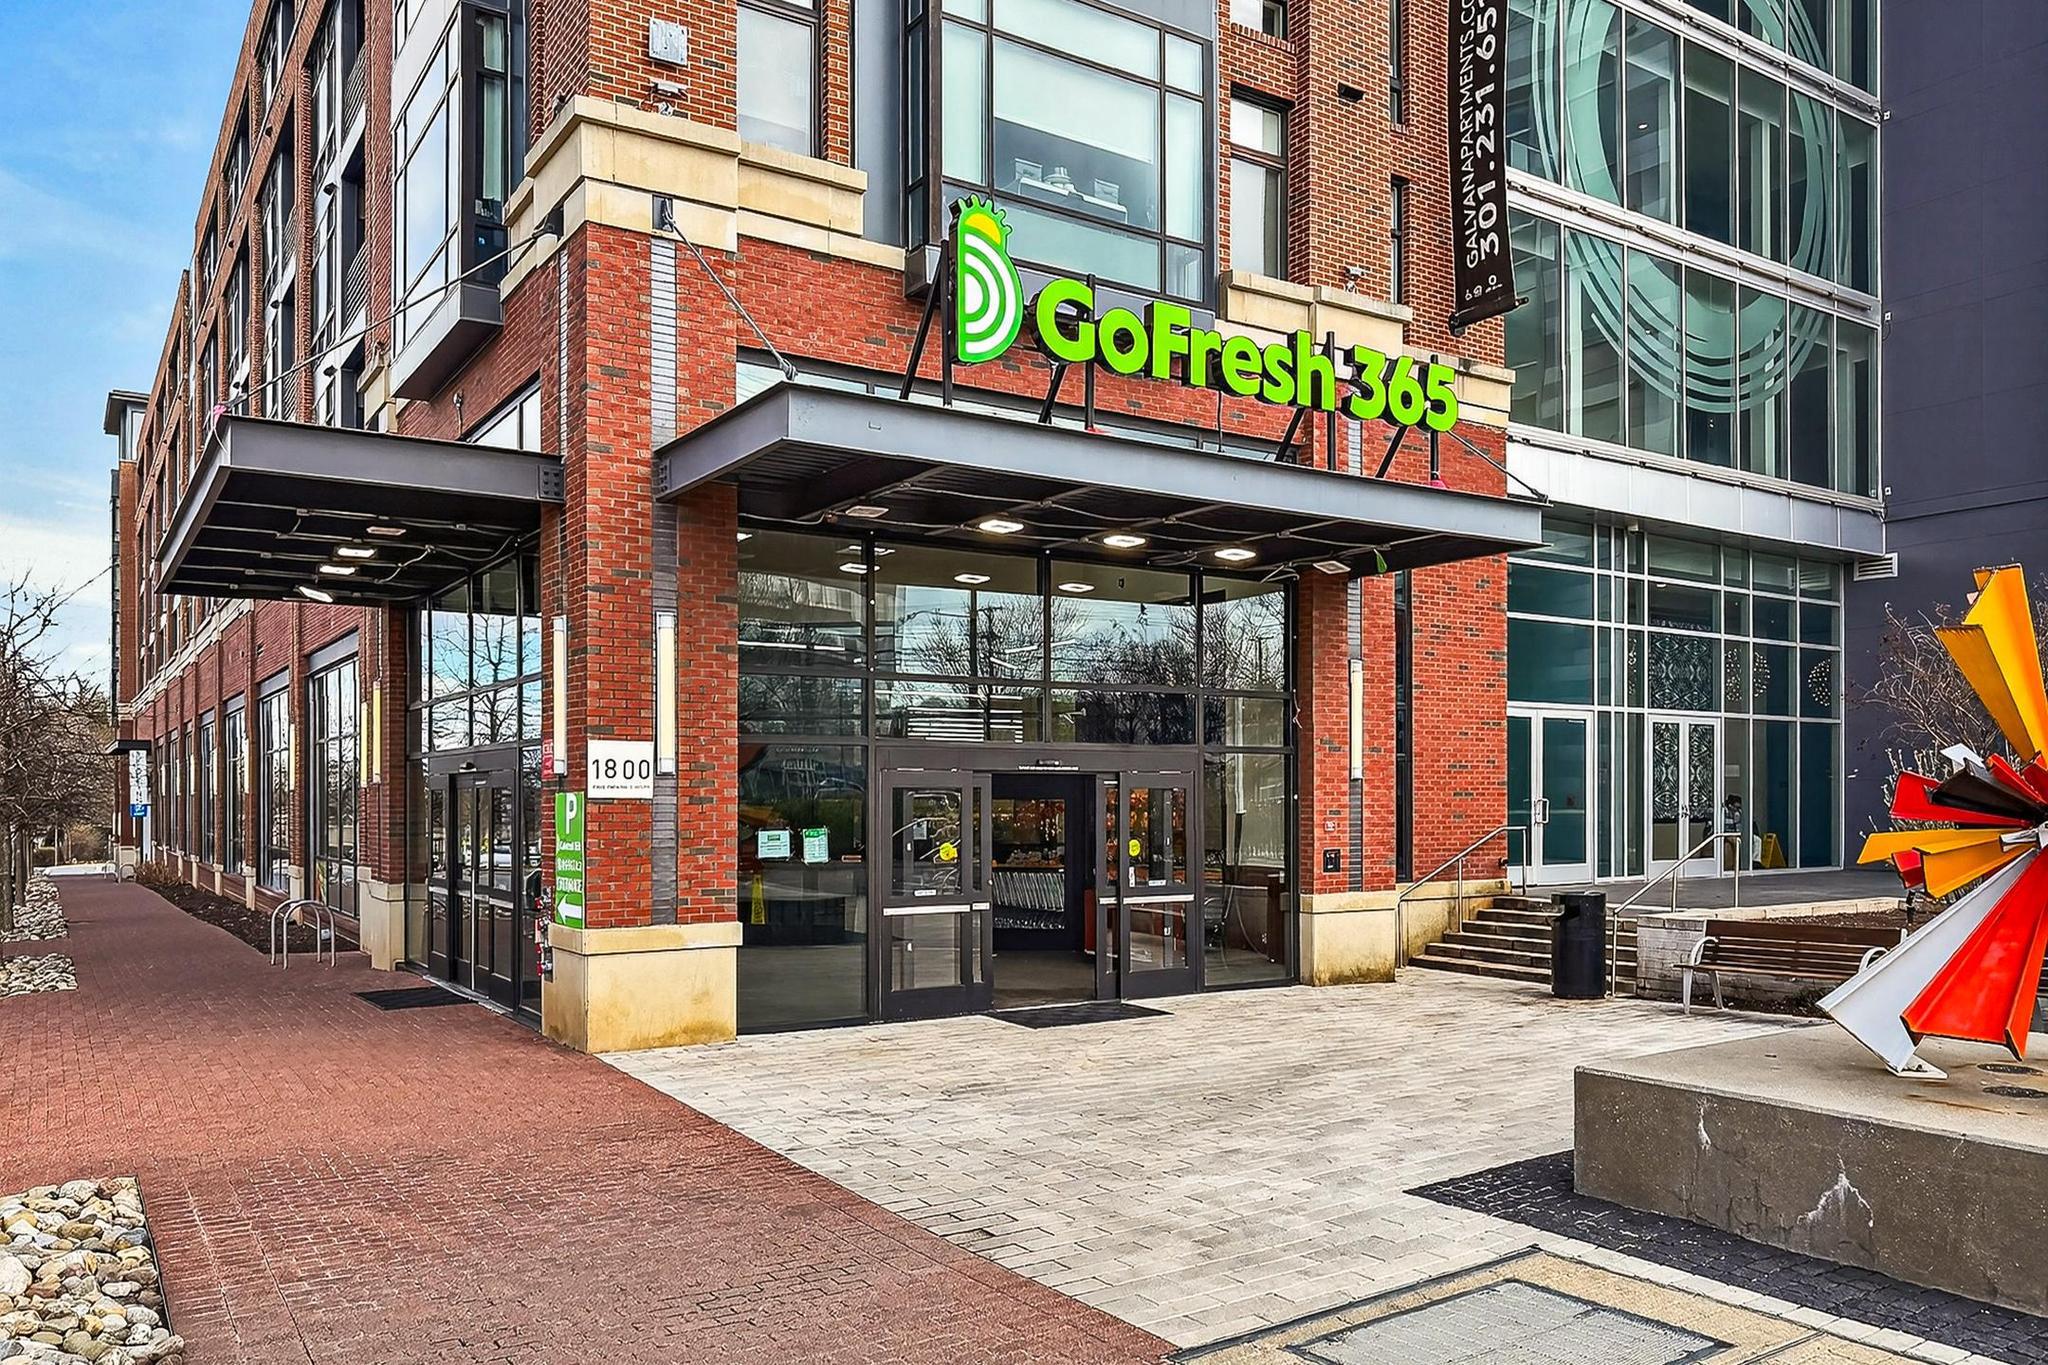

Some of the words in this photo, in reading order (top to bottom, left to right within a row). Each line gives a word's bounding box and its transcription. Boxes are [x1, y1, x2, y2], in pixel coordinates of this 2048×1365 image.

[1476, 0, 1499, 260] 301.231.65
[1036, 277, 1336, 412] GoFresh
[1349, 344, 1459, 432] 365
[565, 792, 578, 835] P
[592, 758, 650, 780] 1800
